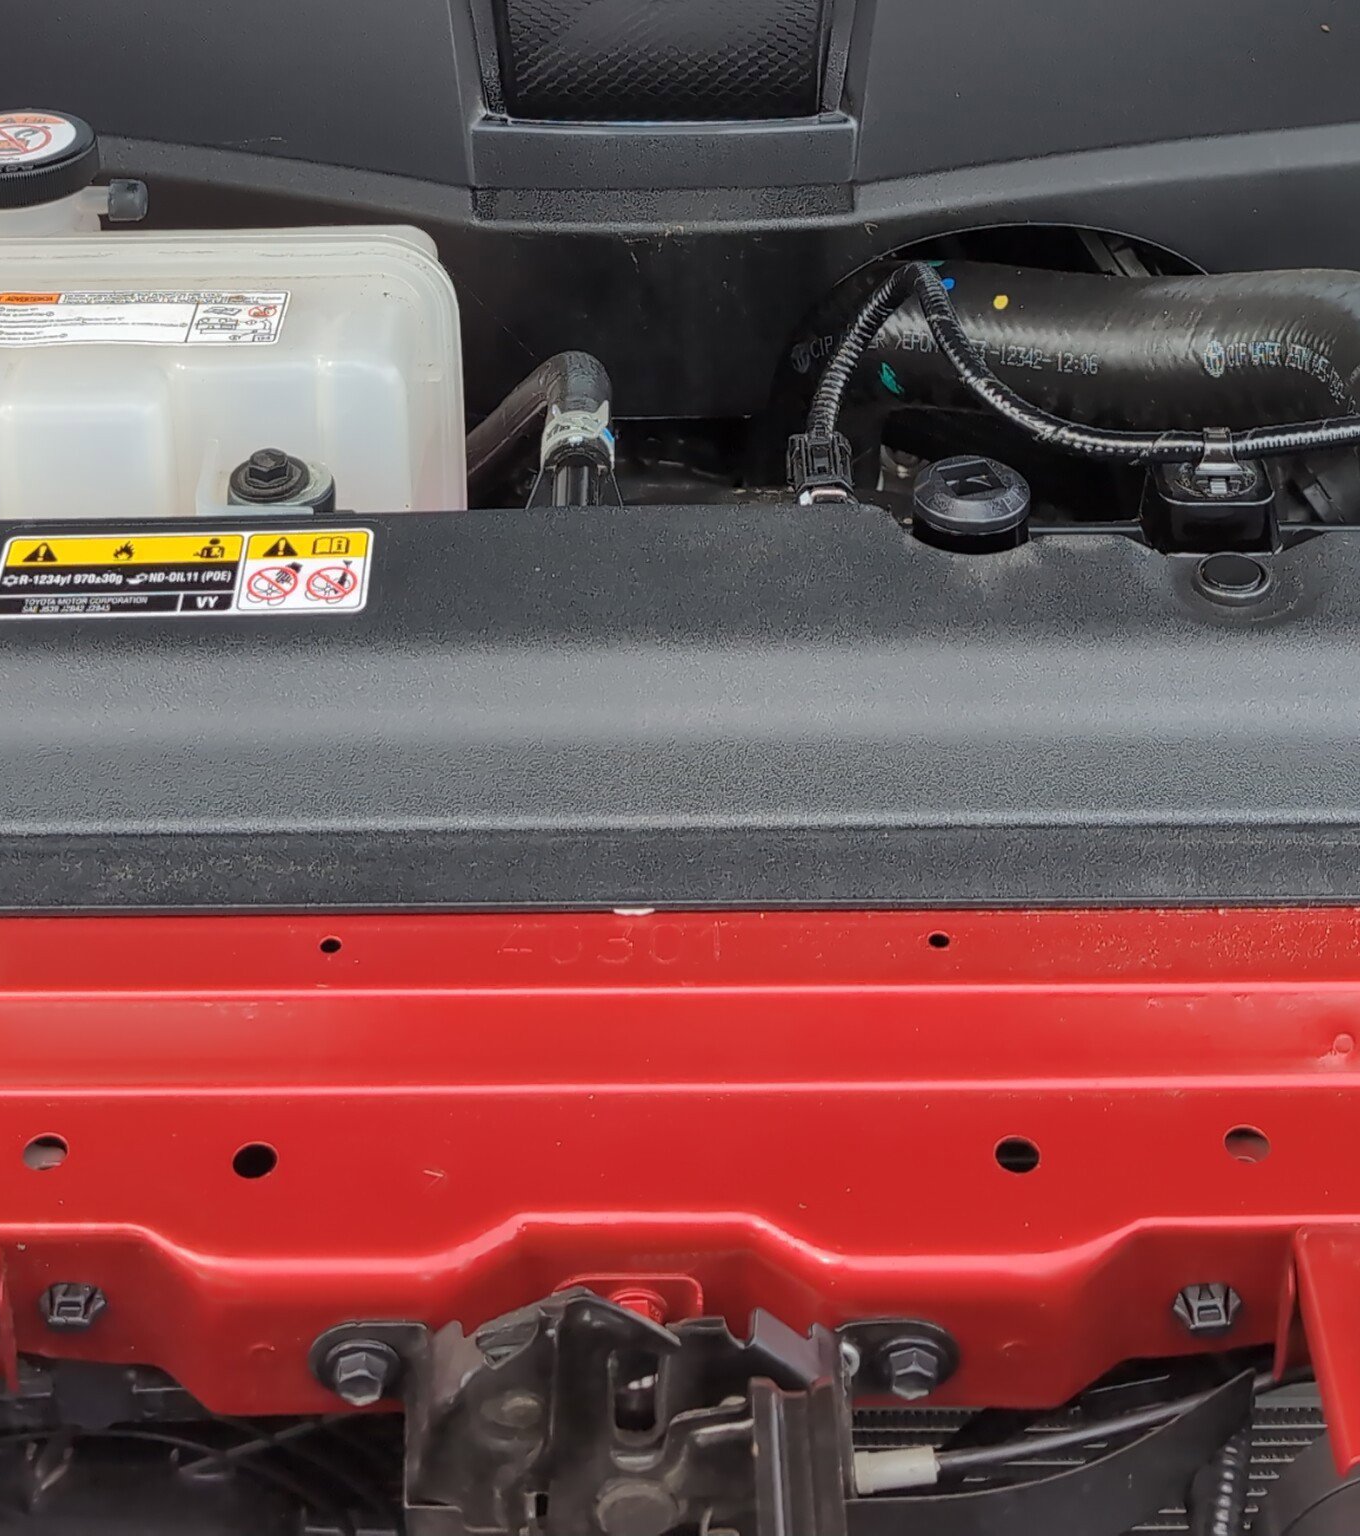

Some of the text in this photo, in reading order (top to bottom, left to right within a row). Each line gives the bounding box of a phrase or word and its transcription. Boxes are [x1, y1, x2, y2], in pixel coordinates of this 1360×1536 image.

[19, 573, 72, 586] R-1234yf
[200, 570, 232, 583] (POE)
[24, 597, 57, 606] TOYOTA
[196, 595, 219, 609] VY
